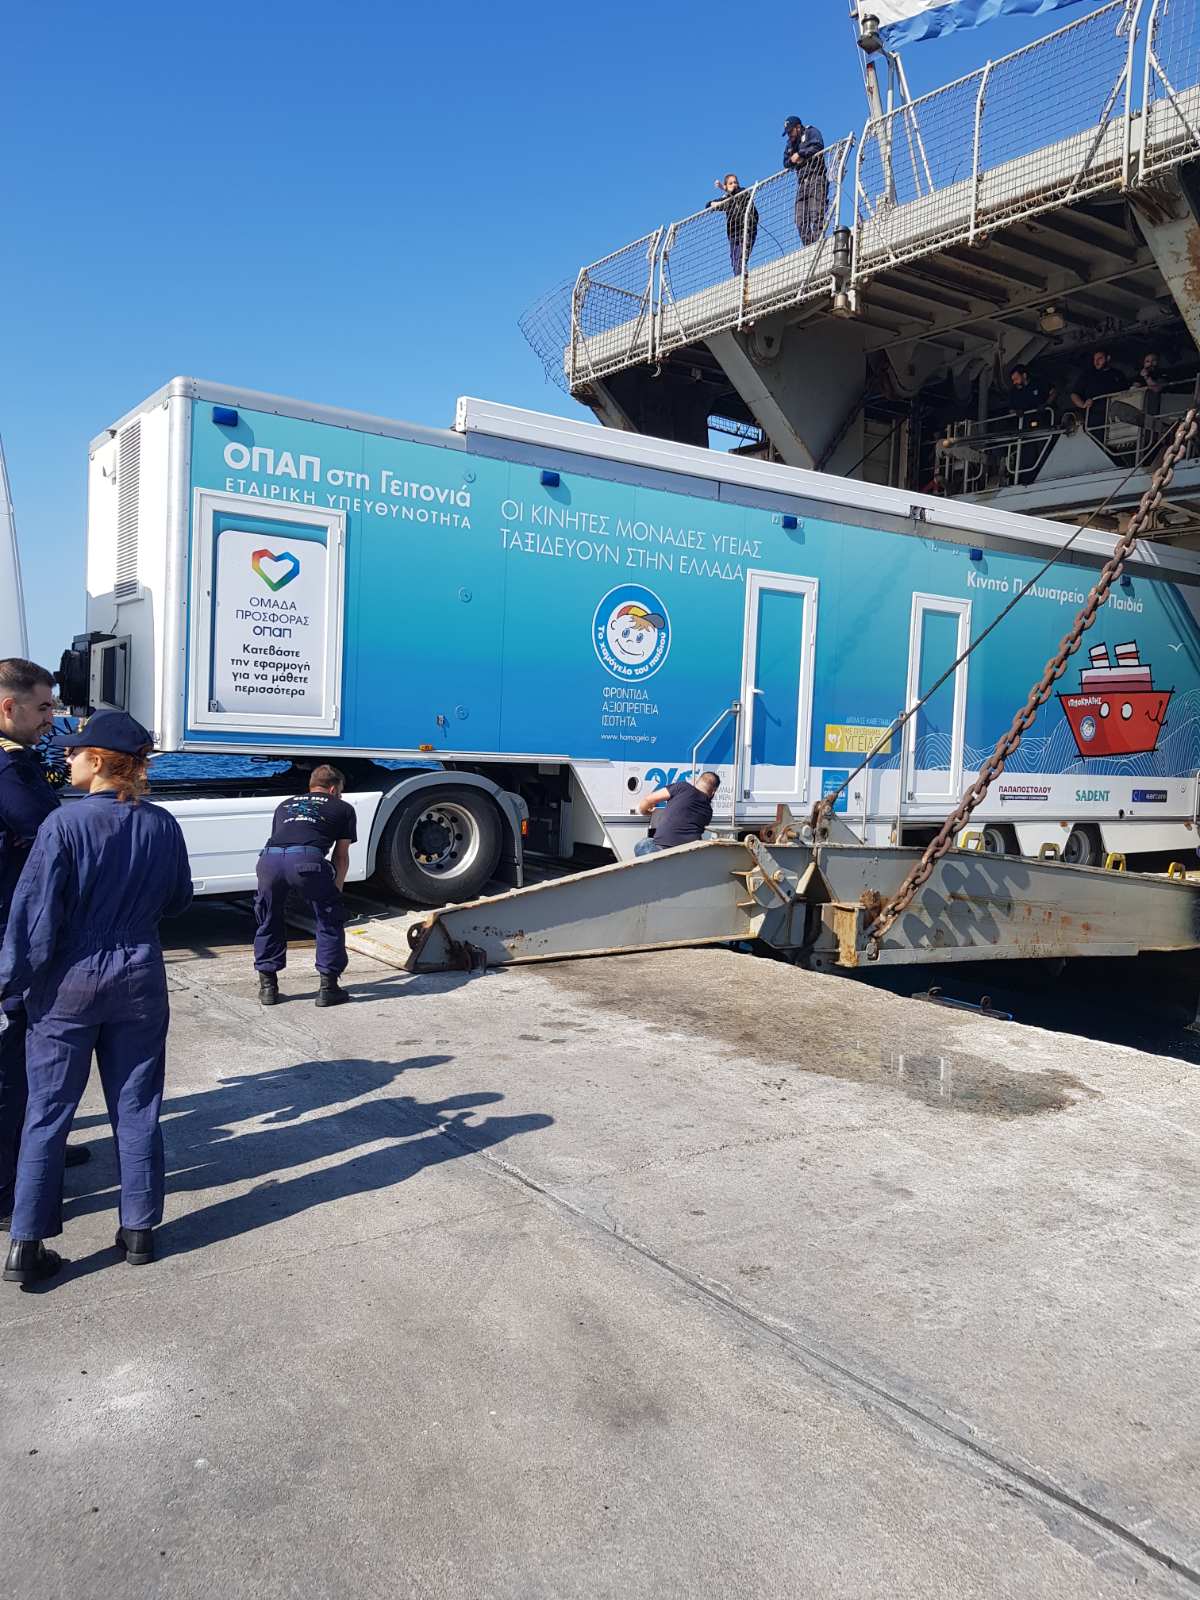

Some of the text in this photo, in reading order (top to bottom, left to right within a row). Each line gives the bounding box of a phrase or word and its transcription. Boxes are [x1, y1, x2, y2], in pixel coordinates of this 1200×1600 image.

[223, 442, 471, 508] ΟΠΑΠ στη Γειτονιά
[225, 477, 471, 529] ΕΤΑΙΡΙΚΗ ΥΠΕΥΘΥΝΟΤΗΤΑ
[501, 500, 762, 559] ΟΙ ΚΙΝΗΤΕΣ ΜΟΝΑΔΕΣ ΥΓΕΙΑΣ
[500, 528, 744, 581] ΤΑΞΙΔΕΥΟΥΝ ΣΤΗΝ ΕΛΛΑΔΑ
[967, 571, 1009, 592] Κινητό
[1108, 594, 1143, 613] Παιδιά
[249, 596, 297, 611] ΟΜΑΔΑ
[235, 609, 310, 626] ΠΡΟΣΦΟΡΑΣ
[242, 644, 300, 658] Κατεβάστε
[231, 657, 311, 673] την εφαρμογή
[232, 671, 309, 685] για να μάθετε
[234, 684, 305, 697] περισσότερα
[602, 687, 649, 701] ΦΡΟΝΤΙΔΑ
[601, 701, 659, 715] ΑΞΙΟΠΡΕΠΕΙΑ
[601, 715, 637, 728] ΙΣΟΤΗΤΑ
[1075, 789, 1110, 802] SADENT
